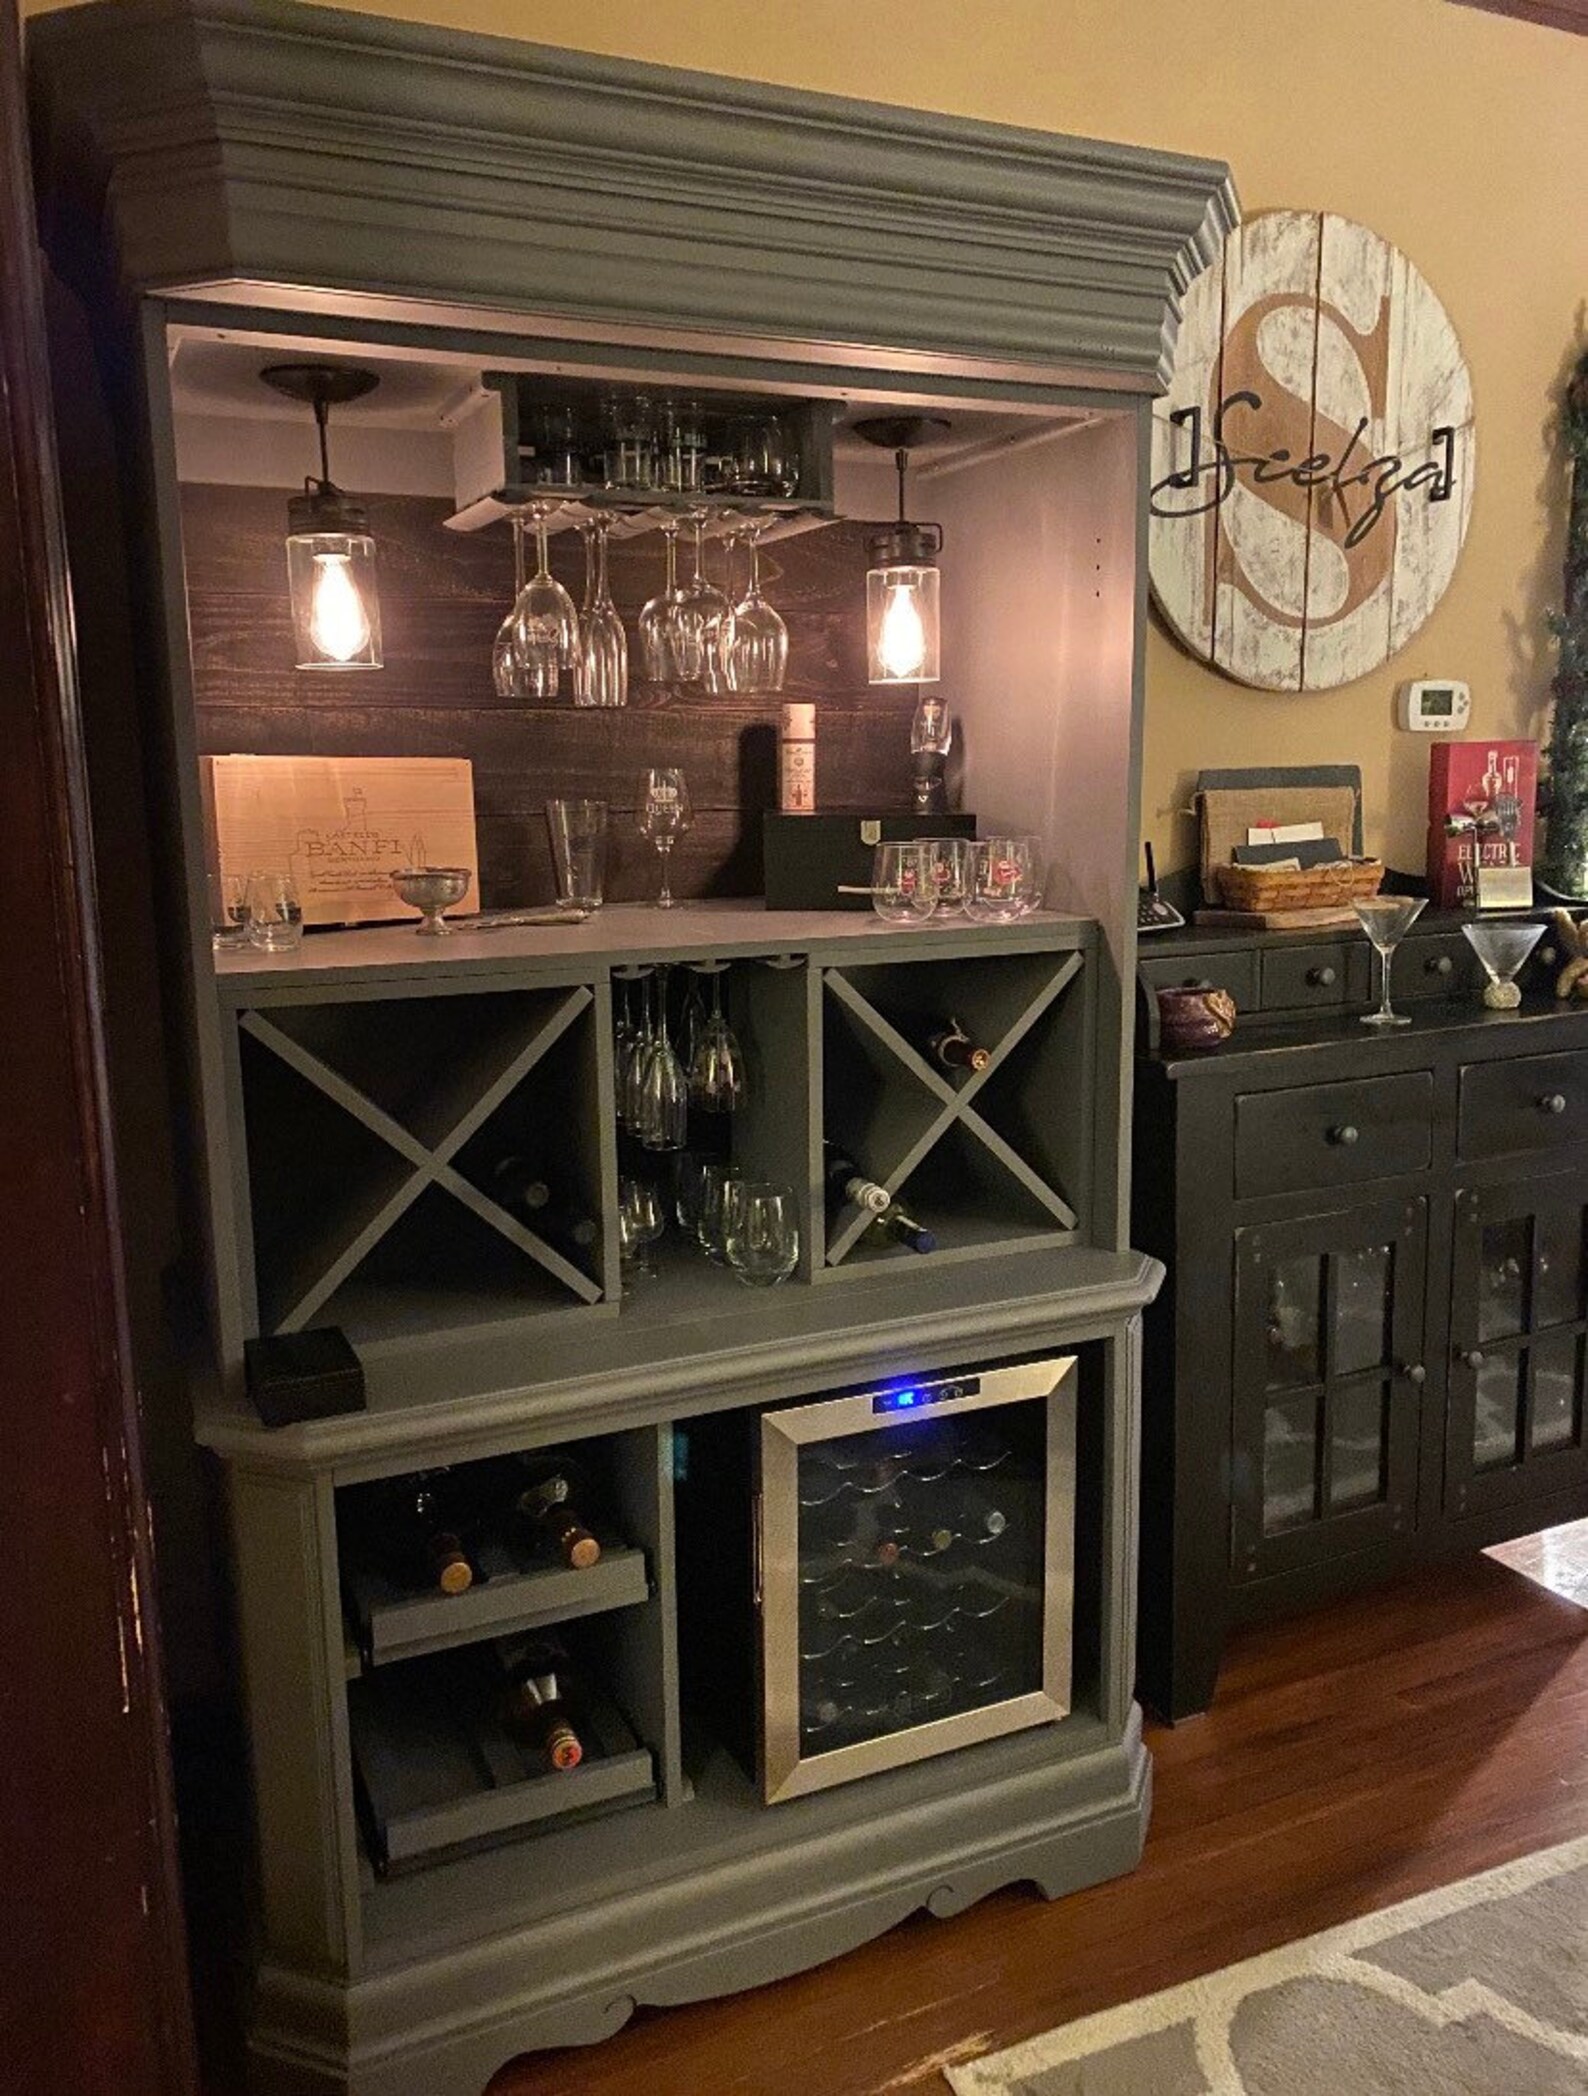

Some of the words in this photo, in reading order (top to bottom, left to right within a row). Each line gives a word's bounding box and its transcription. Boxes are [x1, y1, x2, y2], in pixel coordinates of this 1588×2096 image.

[1203, 291, 1397, 629] S
[304, 840, 402, 857] BANFI
[1458, 843, 1521, 860] ELCTRC
